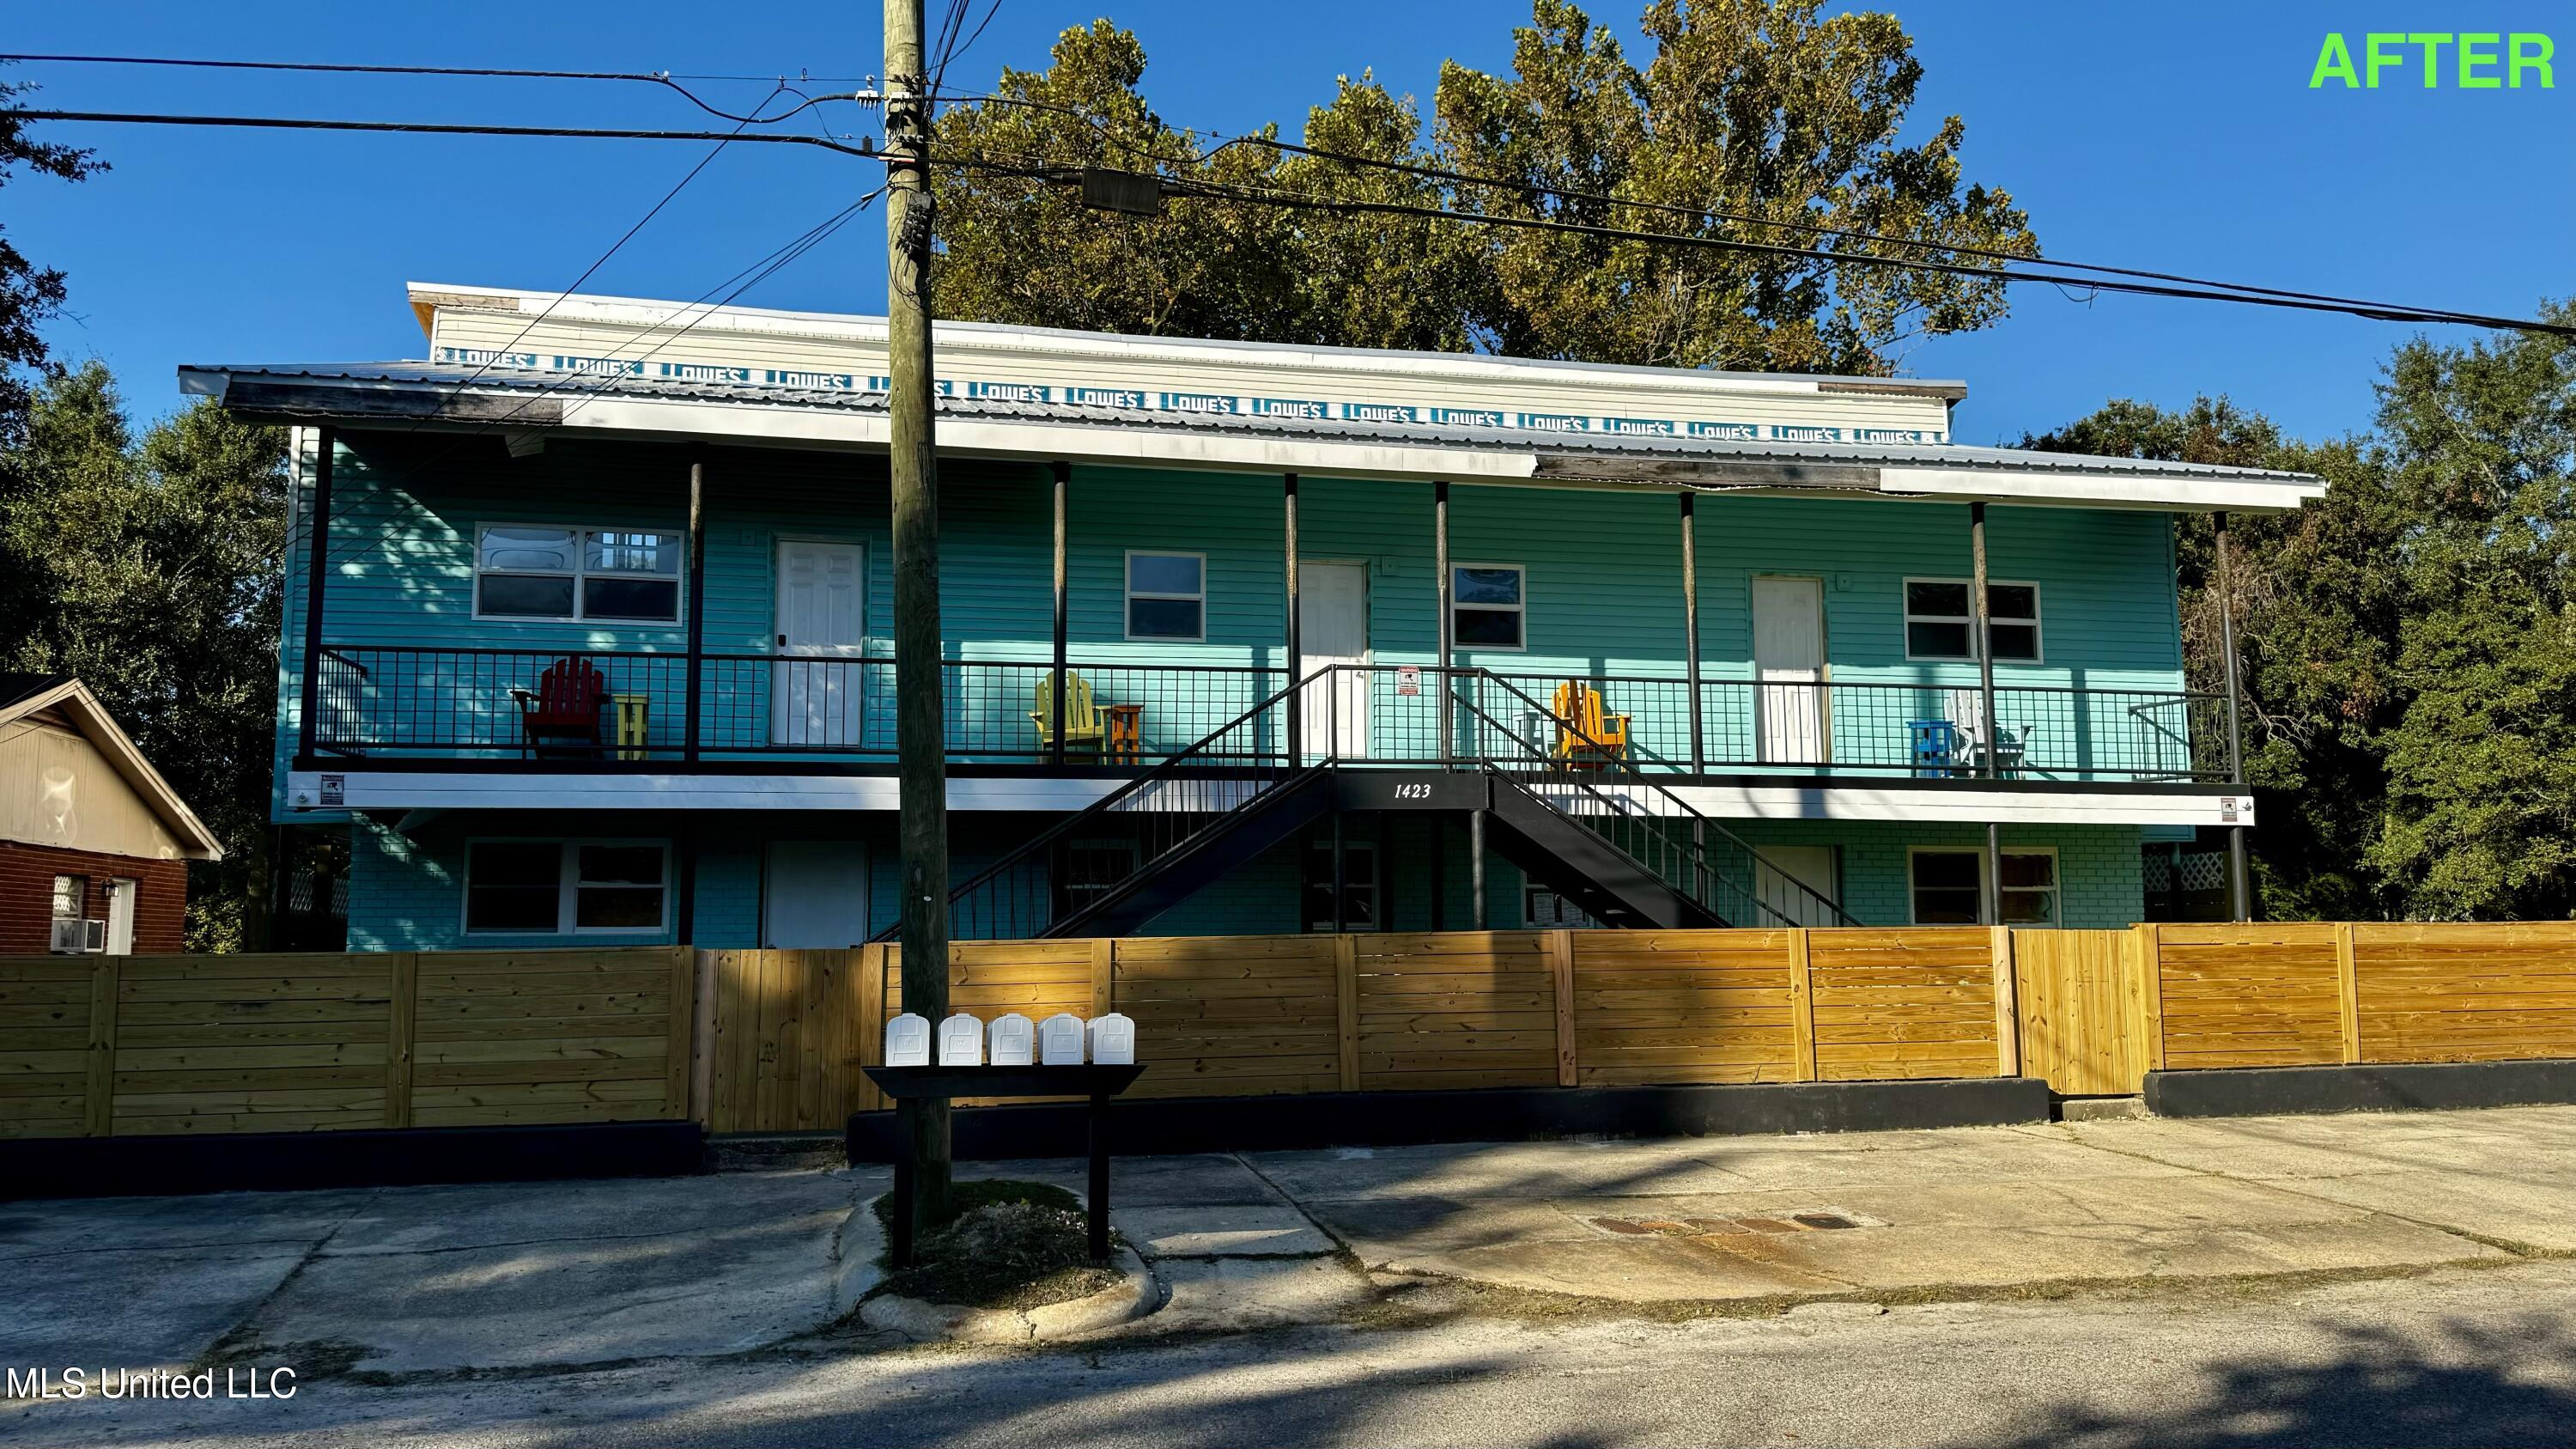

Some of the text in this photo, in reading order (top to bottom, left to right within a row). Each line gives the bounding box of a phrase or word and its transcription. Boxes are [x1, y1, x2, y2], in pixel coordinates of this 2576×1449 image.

[977, 382, 1042, 401] LOWE'S
[1073, 387, 1137, 408] LOWE'S
[1169, 393, 1230, 412] LOWE'S
[1261, 400, 1321, 418] LOWE'S
[1395, 784, 1431, 798] 1423
